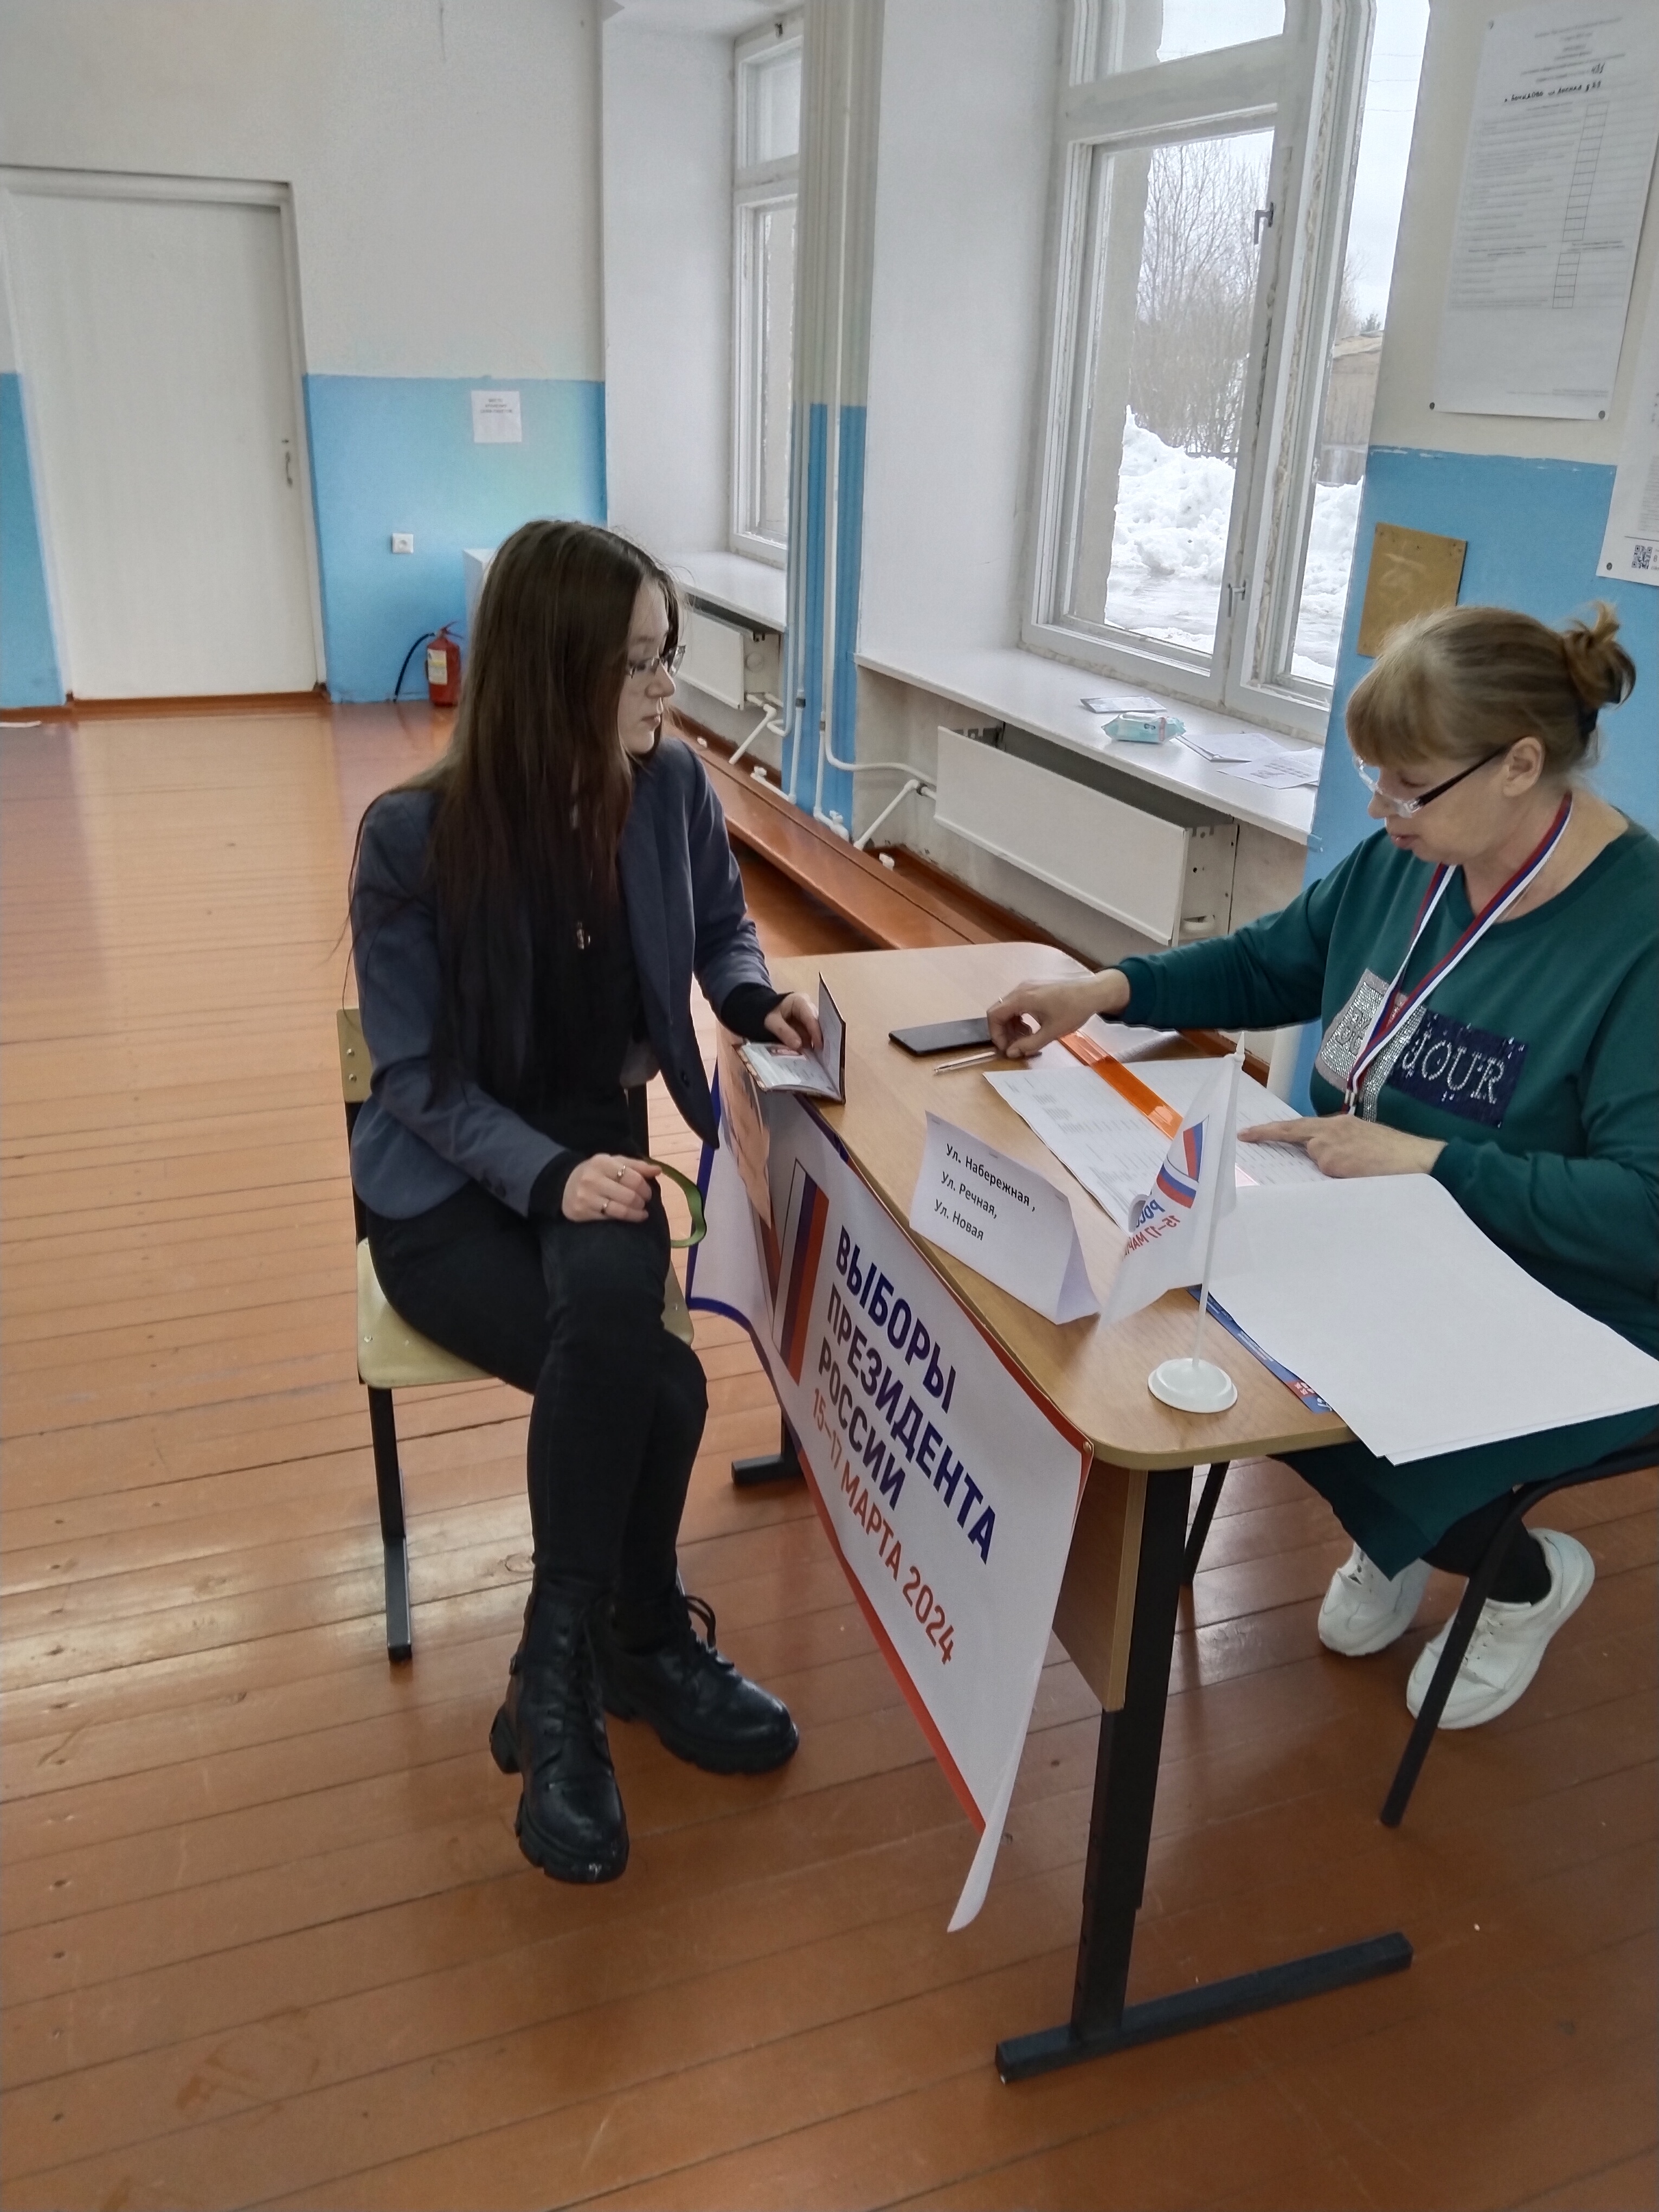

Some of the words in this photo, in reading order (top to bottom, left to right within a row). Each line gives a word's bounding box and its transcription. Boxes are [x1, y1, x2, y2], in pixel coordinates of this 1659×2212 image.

[934, 1199, 949, 1219] Ул.
[952, 1211, 984, 1241] Новая
[941, 1171, 956, 1192] Ул.
[959, 1182, 998, 1219] Речная,
[946, 1143, 961, 1163] Ул.
[965, 1155, 1030, 1207] Набережная
[835, 1224, 956, 1414] ВЫБОРЫ
[818, 1336, 906, 1512] РОССИИ
[827, 1282, 996, 1565] ПРЕЗИДЕНТА
[840, 1459, 902, 1581] МАРТА
[902, 1565, 955, 1665] 2024
